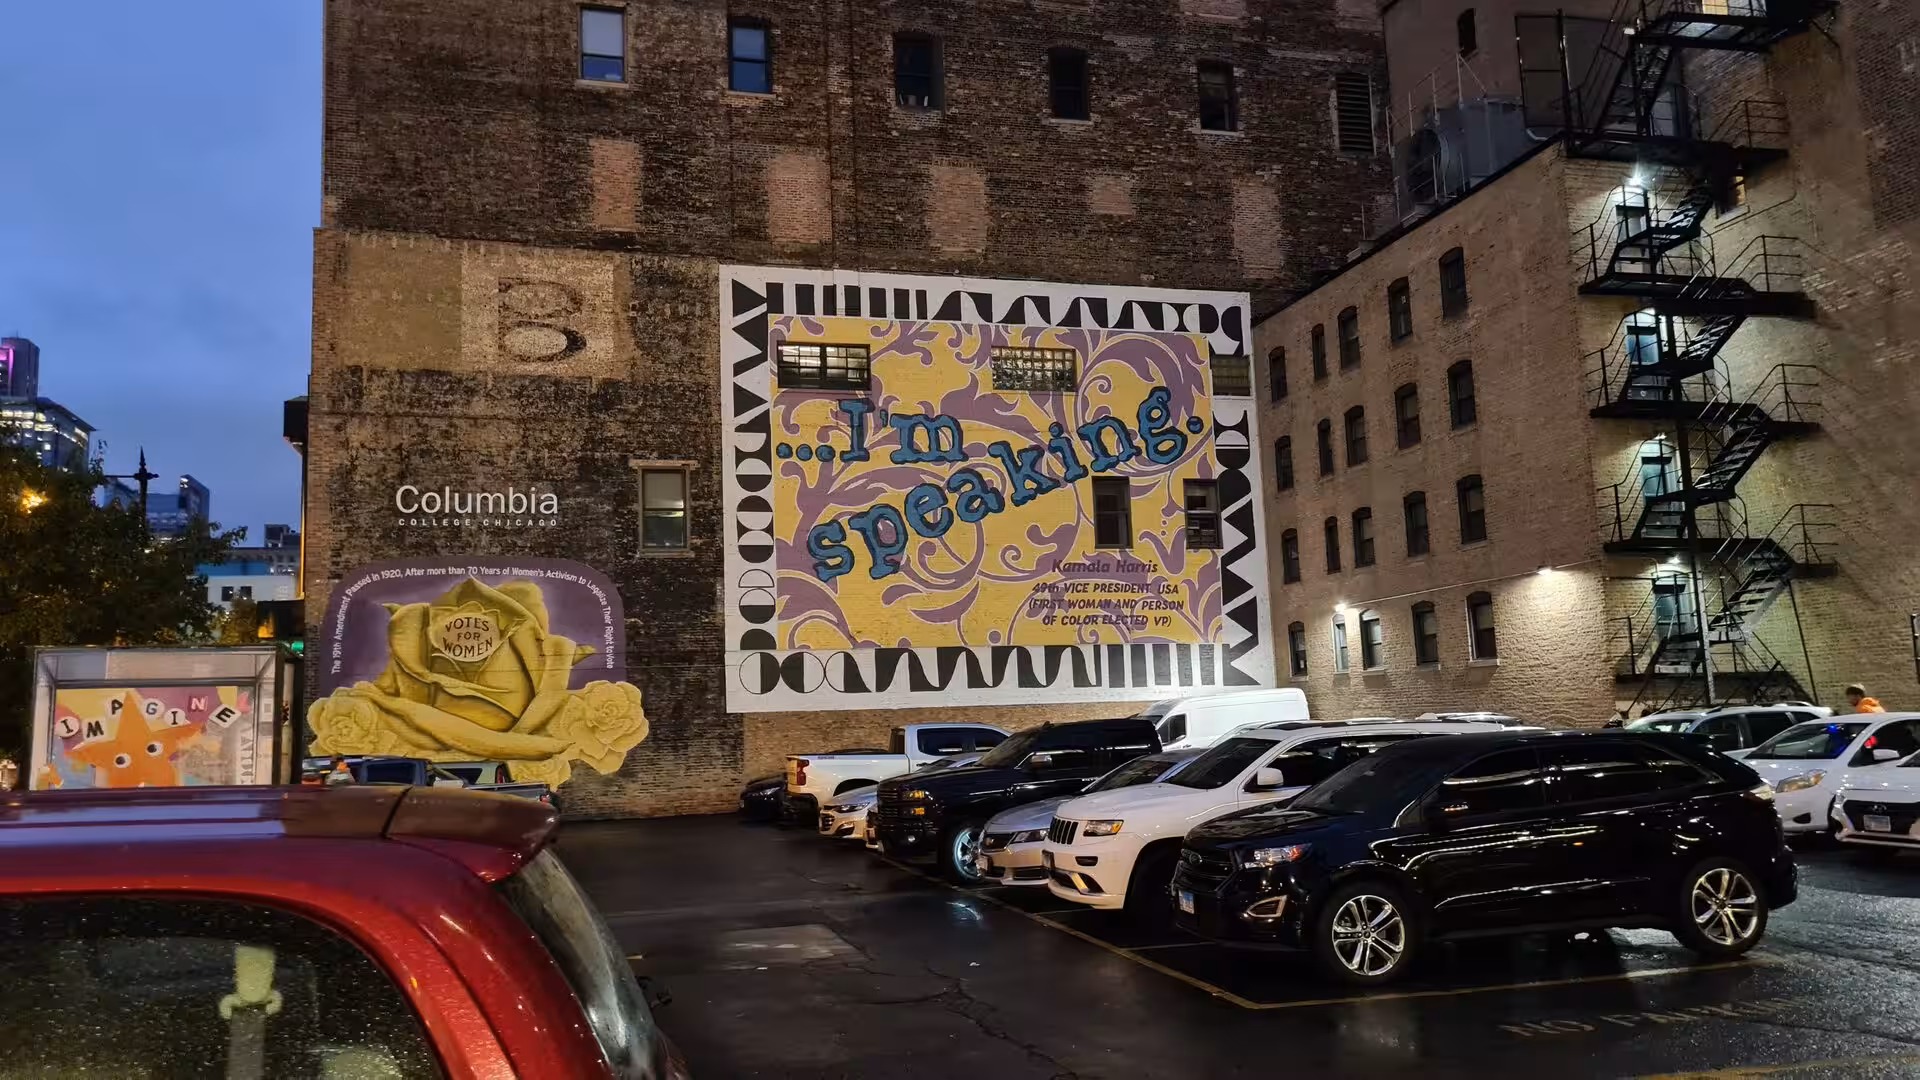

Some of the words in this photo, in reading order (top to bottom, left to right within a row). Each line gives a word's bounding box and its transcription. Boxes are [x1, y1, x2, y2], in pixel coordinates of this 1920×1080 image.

[807, 385, 1206, 583] speaking.
[395, 484, 558, 514] Columbia
[398, 519, 471, 527] COLLEGE
[483, 519, 557, 527] CHICAGO
[405, 568, 425, 577] After
[448, 566, 465, 575] than
[468, 566, 478, 575] 70
[479, 567, 501, 575] Years
[502, 567, 510, 575] of
[511, 567, 544, 577] Women's
[1052, 560, 1110, 573] Kamala
[1115, 560, 1158, 573] Harris
[372, 572, 380, 581] in
[381, 569, 403, 579] 1920,
[545, 569, 578, 582] Activism
[578, 576, 587, 585] to
[345, 575, 372, 597] Passed
[1032, 583, 1059, 593] 49th
[1064, 583, 1090, 594] VICE
[1093, 583, 1151, 594] PRESIDENT
[1158, 584, 1179, 594] USA
[587, 580, 607, 606] Legalize
[1029, 598, 1066, 610] (FIRST
[1068, 599, 1111, 609] WOMAN
[1114, 599, 1137, 610] AND
[1141, 600, 1185, 610] PERSON
[334, 596, 351, 640] Amendment
[603, 606, 612, 625] Their
[1042, 616, 1057, 626] OF
[1061, 615, 1098, 626] COLOR
[1102, 614, 1148, 625] ELECTED
[1154, 616, 1172, 627] VP)
[445, 616, 490, 632] VOTES
[457, 631, 481, 641] FOR
[605, 625, 614, 645] Right
[333, 642, 342, 659] 19th
[442, 637, 493, 658] WOMEN
[331, 660, 341, 675] The
